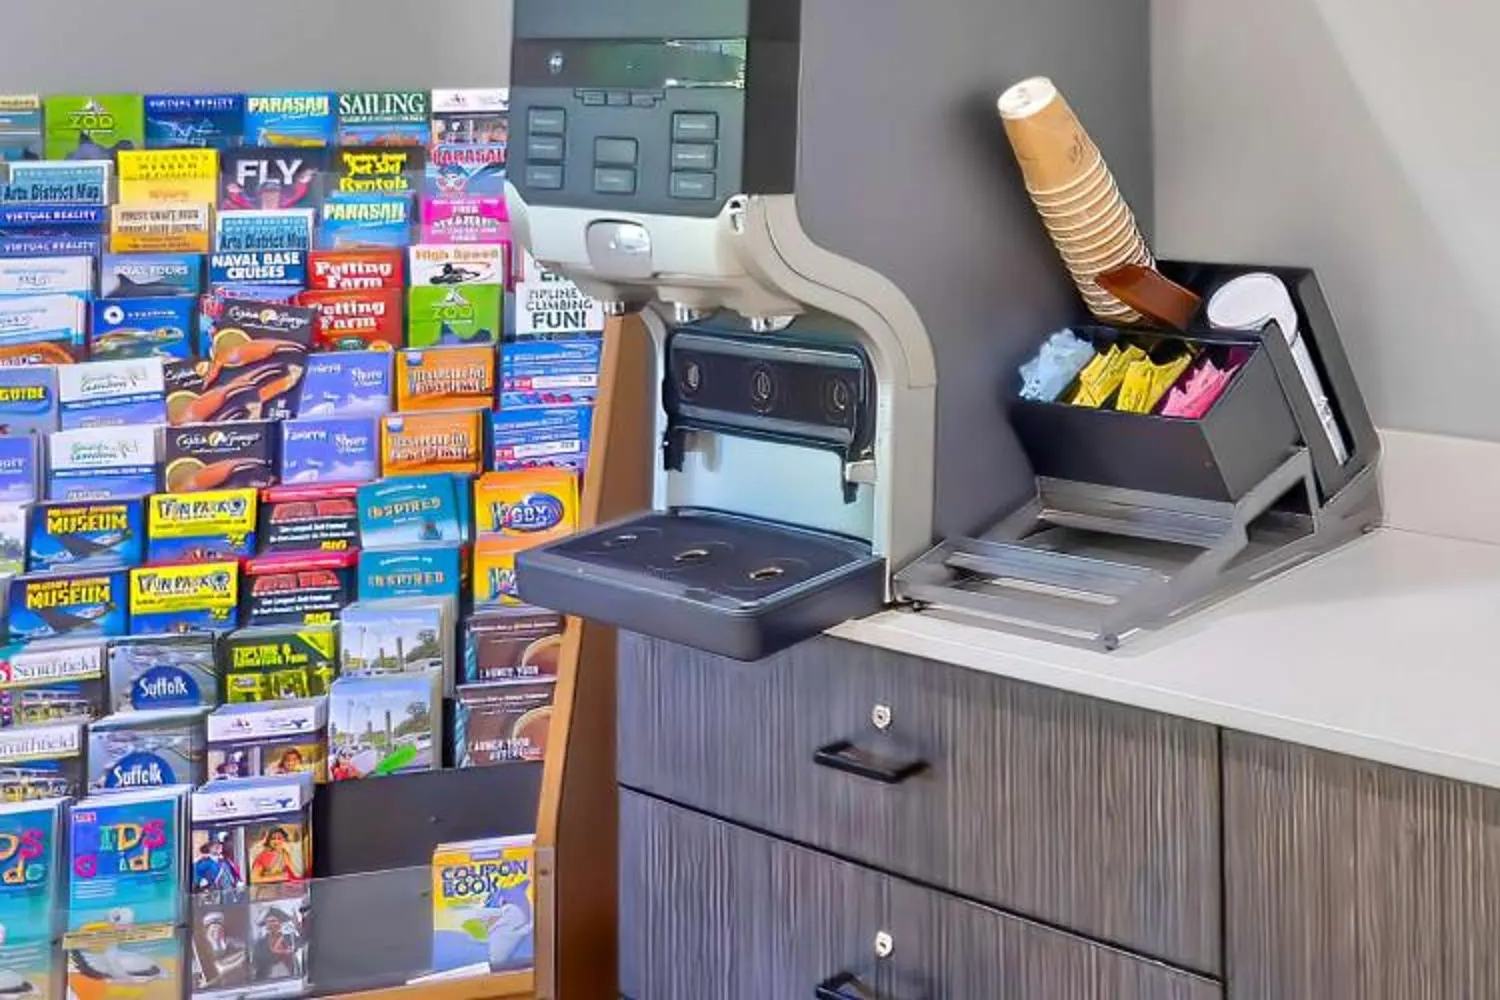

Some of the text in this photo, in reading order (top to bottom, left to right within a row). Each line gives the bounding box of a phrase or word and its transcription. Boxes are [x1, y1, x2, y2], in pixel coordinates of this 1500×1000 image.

[339, 93, 424, 115] SAILING
[69, 115, 113, 128] ZOO
[236, 159, 303, 185] FLY
[4, 185, 28, 200] Arts
[32, 183, 74, 200] District
[6, 210, 97, 222] VIRTUAL REALITY
[5, 241, 95, 253] VIRTUAL REALITY
[220, 234, 242, 249] Arts
[244, 233, 284, 249] District
[212, 252, 300, 267] NAVAL BASE
[227, 265, 285, 279] CRUISES
[315, 261, 392, 278] Petting
[327, 275, 382, 289] Farm
[526, 300, 593, 312] CLIMBING
[320, 316, 376, 329] Farm
[532, 311, 587, 329] FUN!
[47, 514, 128, 534] MUSEUM
[27, 585, 111, 609] MUSEUM
[139, 677, 188, 697] Suffolk
[113, 763, 163, 786] Suffolk
[442, 859, 529, 880] COUPON
[444, 876, 500, 898] BOOK
